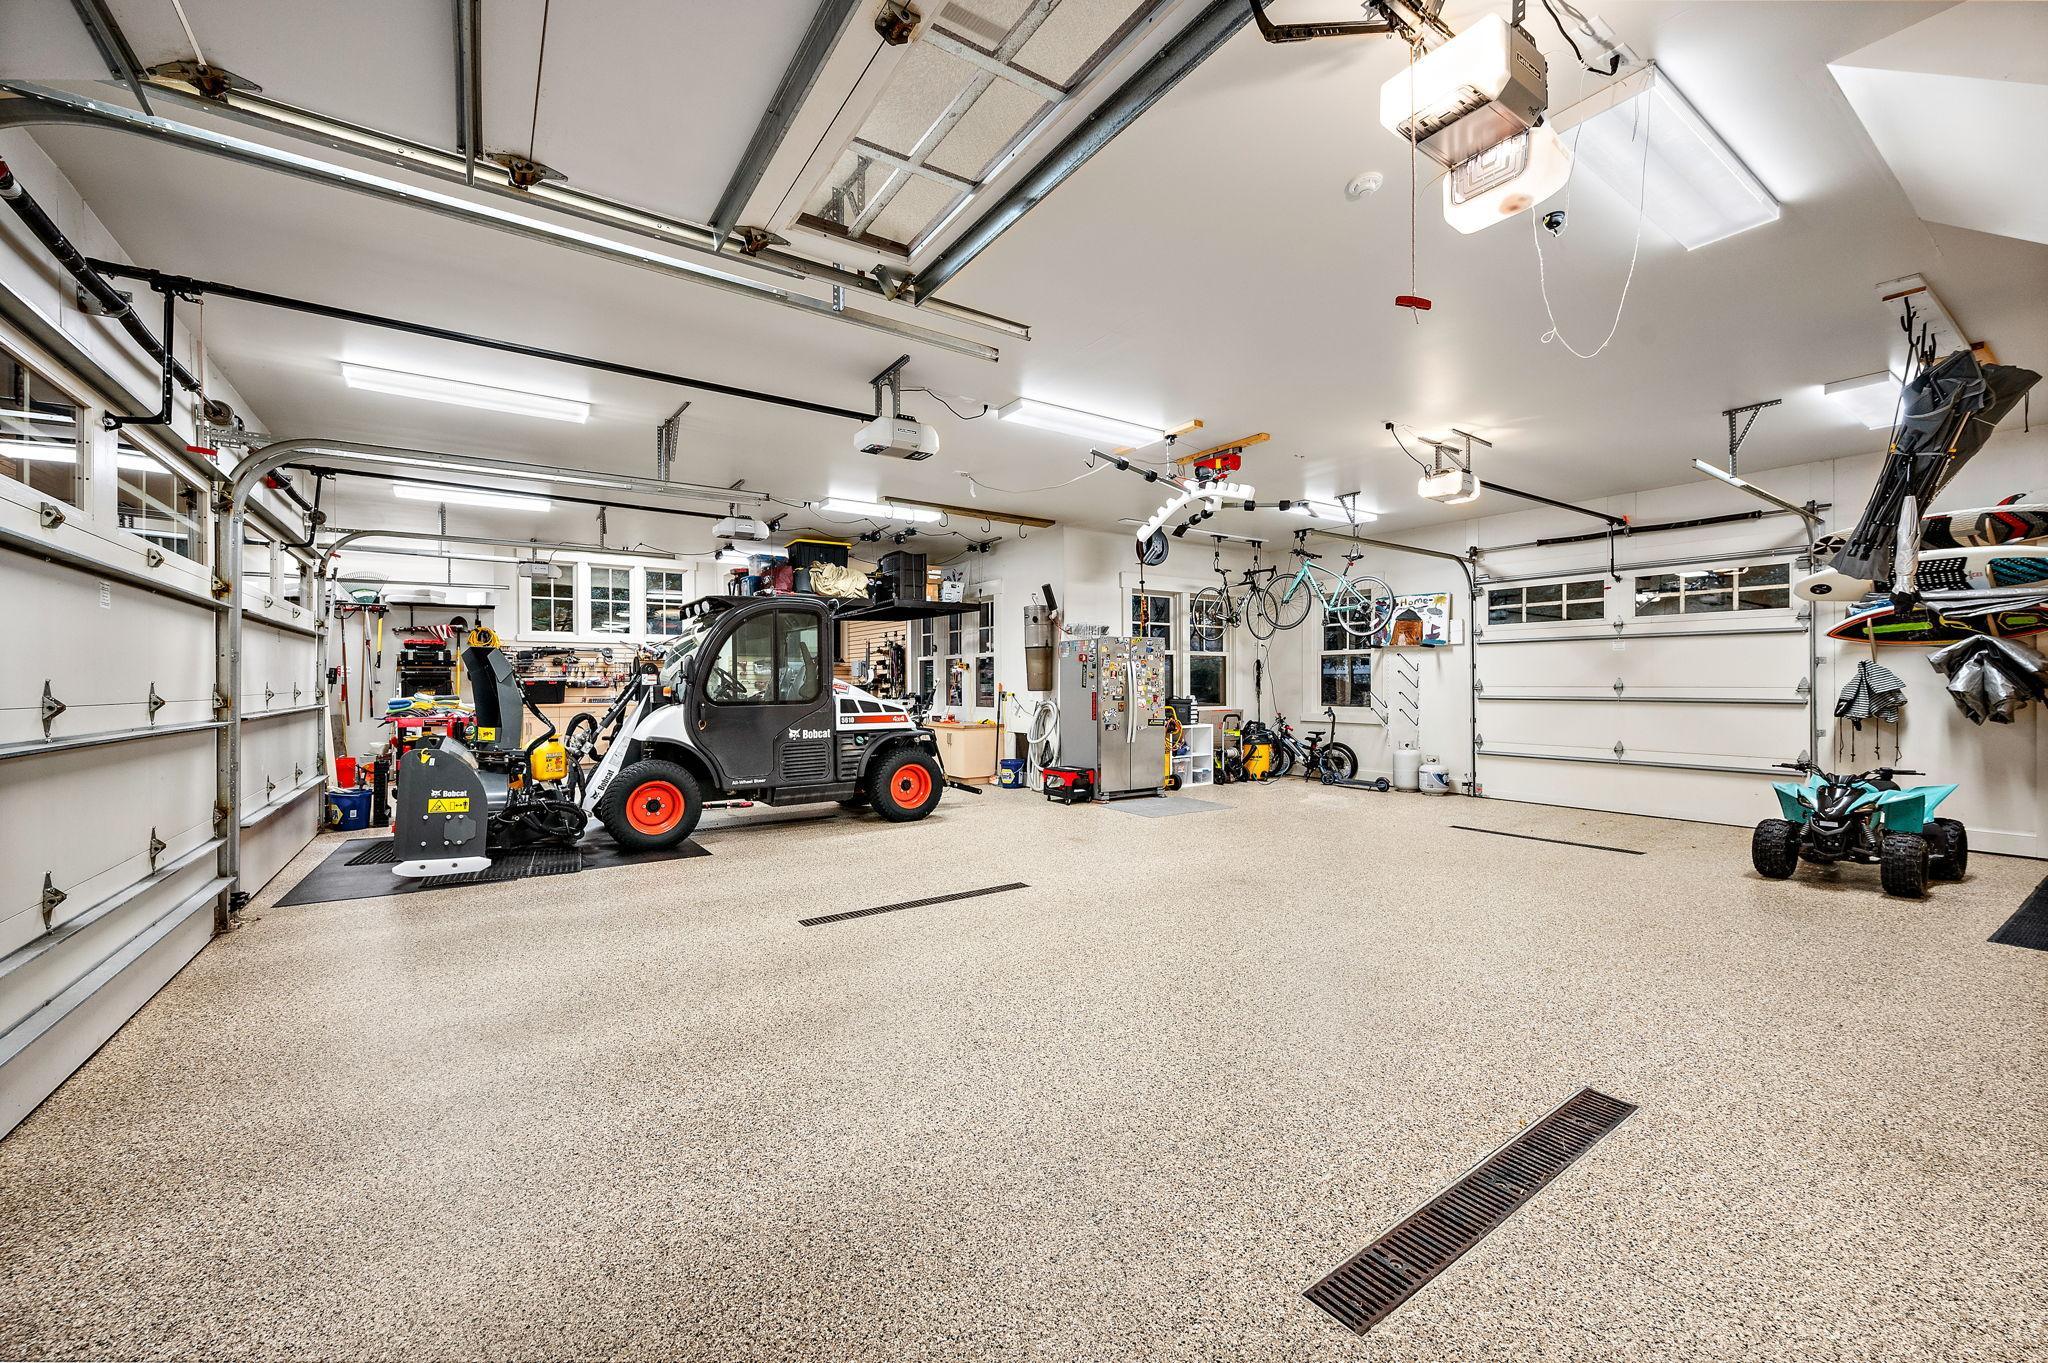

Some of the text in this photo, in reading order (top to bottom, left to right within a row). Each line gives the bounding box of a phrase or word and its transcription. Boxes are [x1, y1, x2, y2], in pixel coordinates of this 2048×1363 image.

[802, 729, 831, 739] Bobcat
[598, 769, 615, 790] Bobcat
[442, 790, 467, 798] Bobcat
